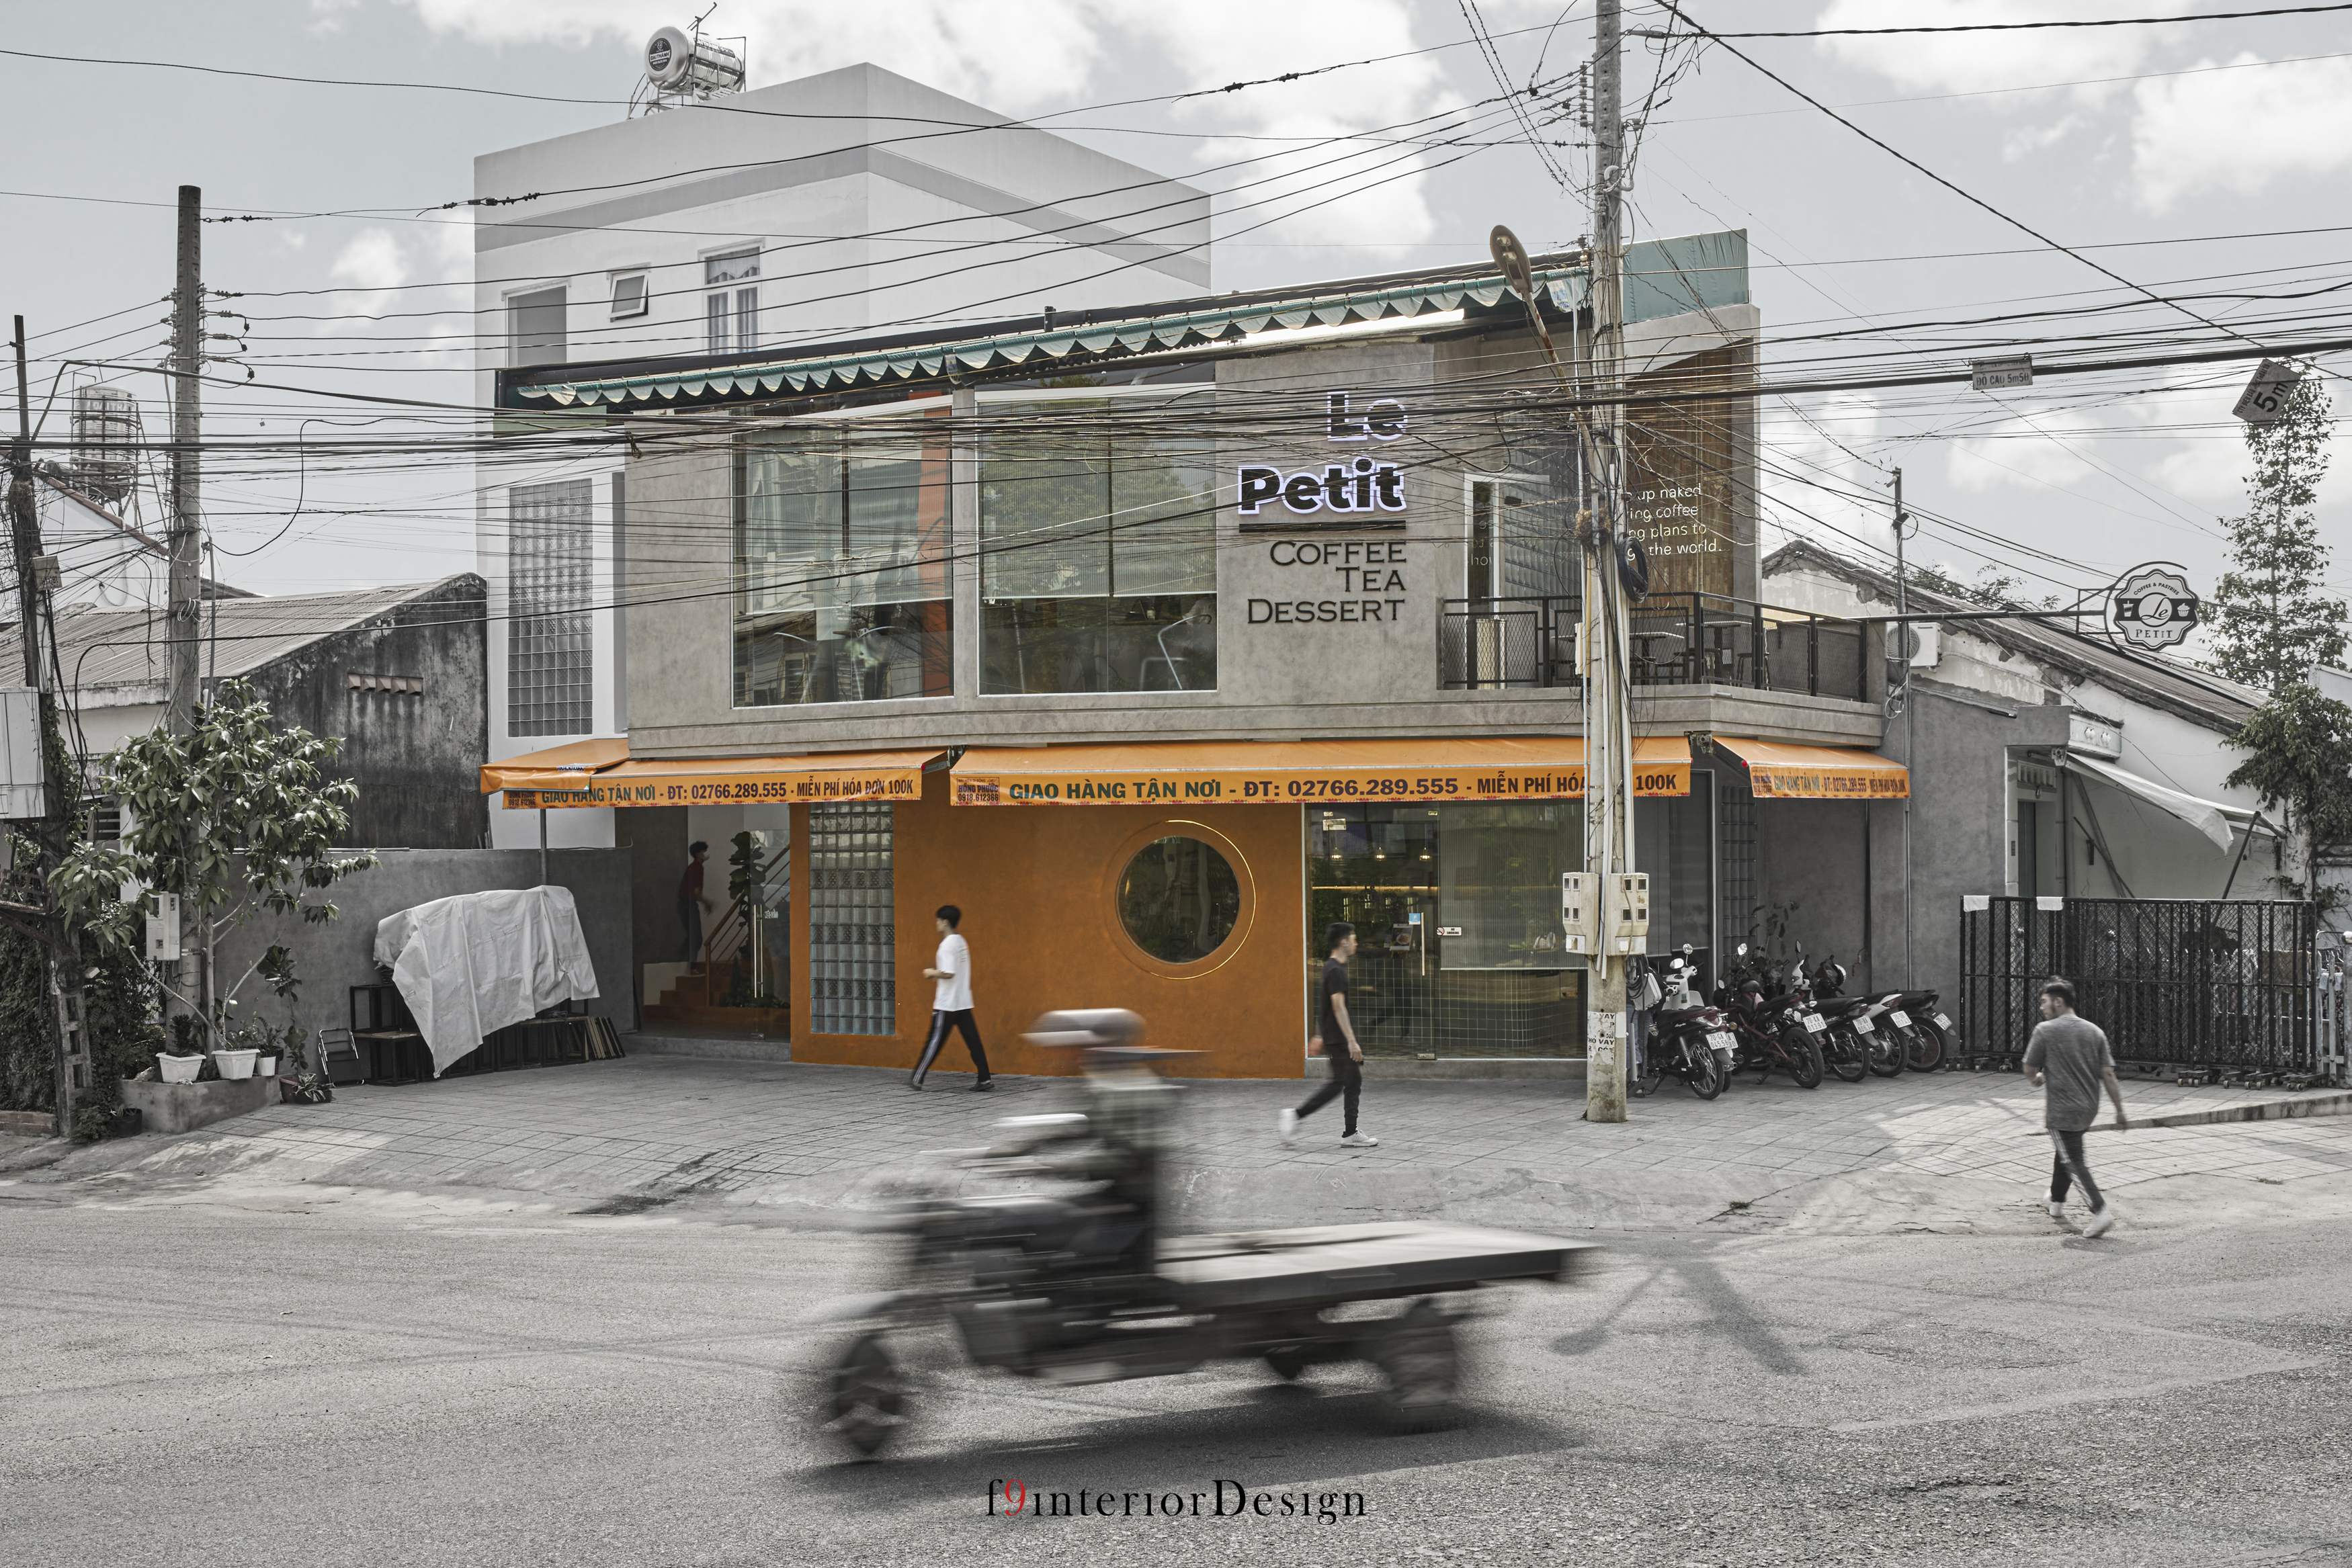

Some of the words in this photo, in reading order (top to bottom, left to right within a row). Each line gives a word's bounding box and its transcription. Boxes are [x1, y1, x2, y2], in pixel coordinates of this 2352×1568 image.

[1990, 375, 2005, 385] CAO
[1327, 392, 1408, 441] Le
[1238, 455, 1406, 515] Petit
[1638, 490, 1655, 502] up
[1660, 482, 1702, 499] naked
[1656, 504, 1698, 518] coffee
[1650, 524, 1687, 539] plans
[1692, 524, 1707, 534] to
[1270, 540, 1406, 566] COFFEE
[1648, 542, 1671, 556] the
[1336, 566, 1406, 592] TEA
[2134, 583, 2151, 595] COFFEE
[2158, 582, 2180, 595] PASTRIES
[1248, 599, 1404, 623] DESSERT
[2141, 597, 2169, 620] Le
[542, 791, 569, 803] GIAO
[607, 784, 631, 804] TẬN
[667, 785, 687, 800] ĐT:
[691, 782, 786, 799] 02766.289.555
[797, 775, 821, 797] MIỄN
[824, 777, 839, 796] PHÍ
[842, 777, 862, 795] HÓA
[888, 779, 913, 794] 100K
[1009, 783, 1059, 799] GIAO
[1066, 779, 1126, 799] HÀNG
[1132, 778, 1177, 801] TẬN
[1185, 779, 1221, 797] NƠI
[1244, 781, 1279, 797] ĐT:
[1288, 778, 1458, 797] 02766.289.555
[1477, 771, 1518, 793] MIỄN
[1524, 773, 1550, 793] PHÍ
[1636, 775, 1677, 791] 100K
[958, 793, 999, 801] 0918.612366
[1710, 1039, 1729, 1048] 045.56
